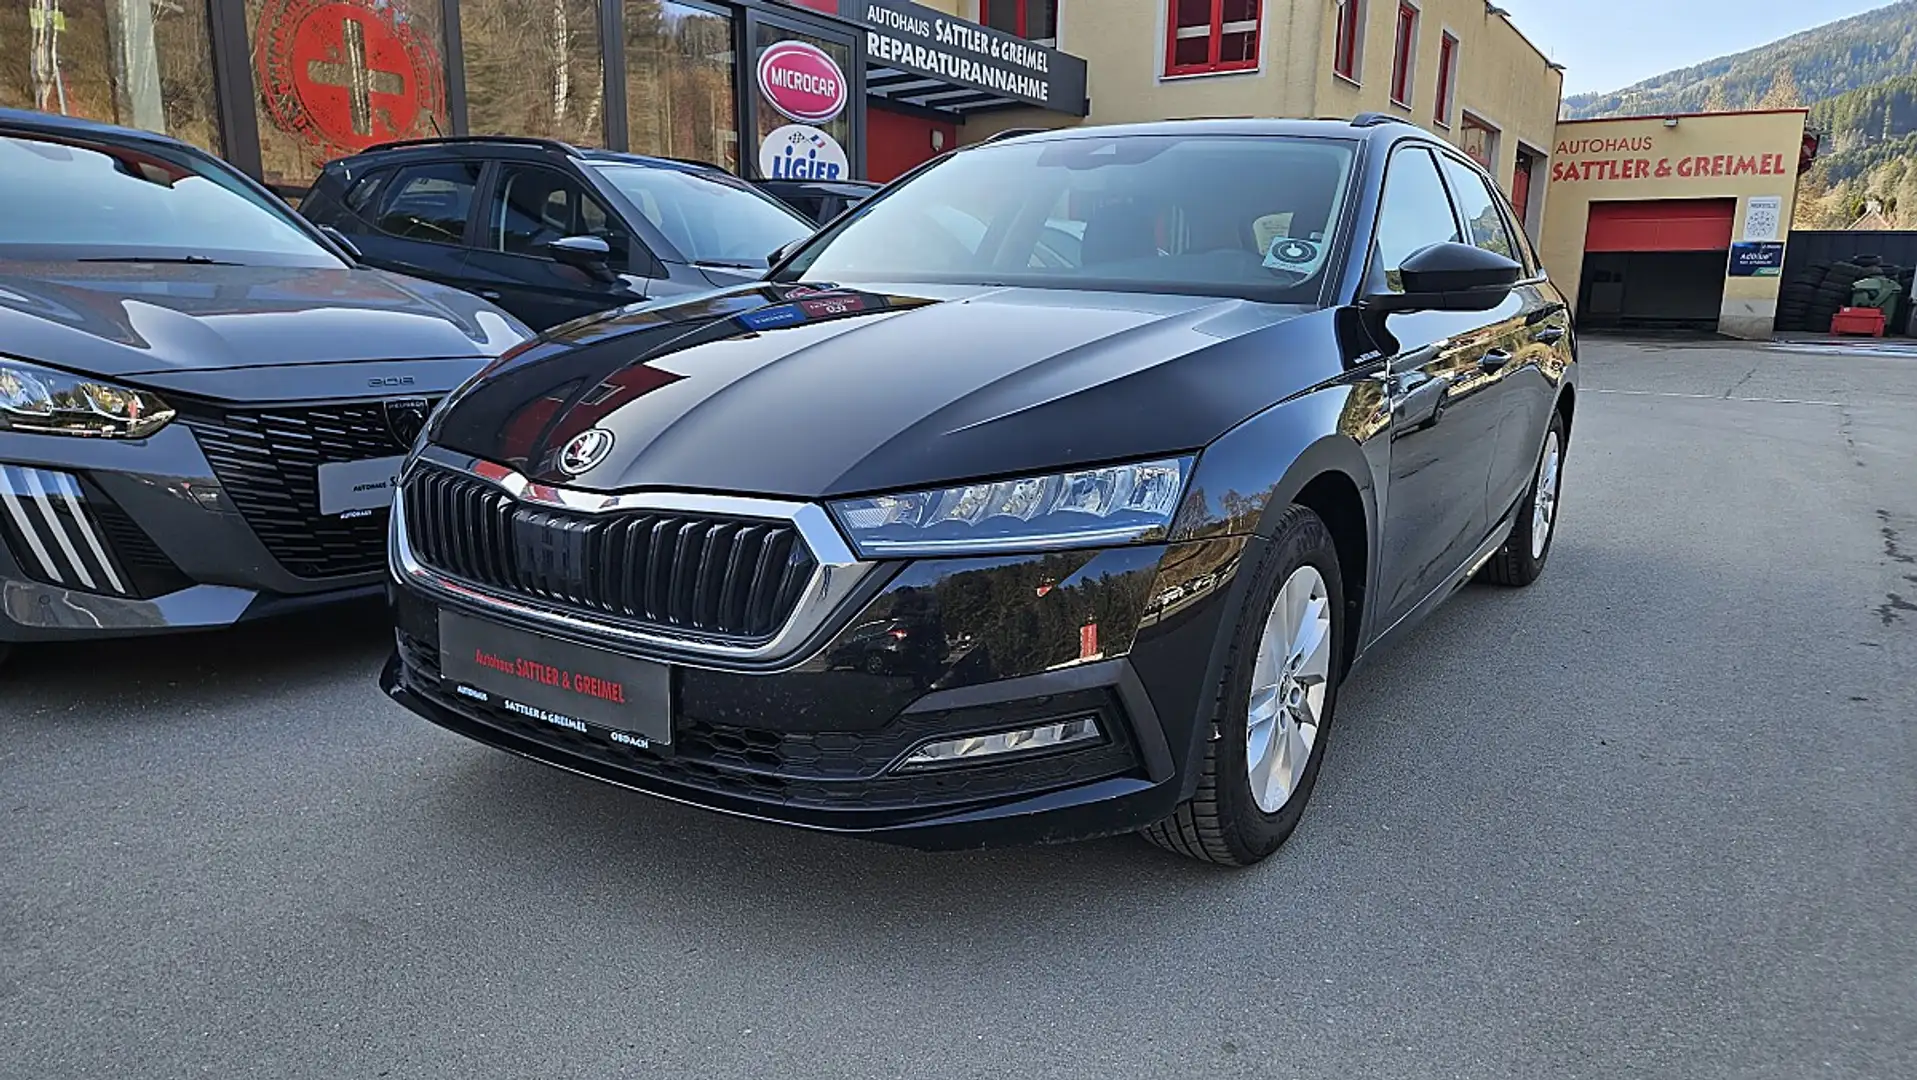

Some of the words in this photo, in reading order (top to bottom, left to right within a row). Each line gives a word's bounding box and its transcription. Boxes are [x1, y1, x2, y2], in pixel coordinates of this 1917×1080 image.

[867, 5, 930, 38] AUTOHAUS
[935, 18, 989, 55] SATTLER
[990, 37, 1000, 59] &
[1001, 41, 1048, 74] GREIMEL
[771, 66, 836, 99] MICROCAR
[867, 31, 1048, 101] REPARATURANNAHME
[1555, 136, 1653, 155] AUTOHAUS
[1552, 158, 1651, 183] SATTLER
[1653, 158, 1673, 178] &
[1677, 153, 1786, 178] GREIMEL
[475, 650, 515, 674] Autohaus
[516, 658, 559, 688] SATTLER
[561, 671, 571, 690] &
[575, 673, 625, 704] GREIMEL
[504, 699, 540, 720] SATTLER
[539, 709, 548, 721] &
[548, 713, 588, 733] GREIMEL
